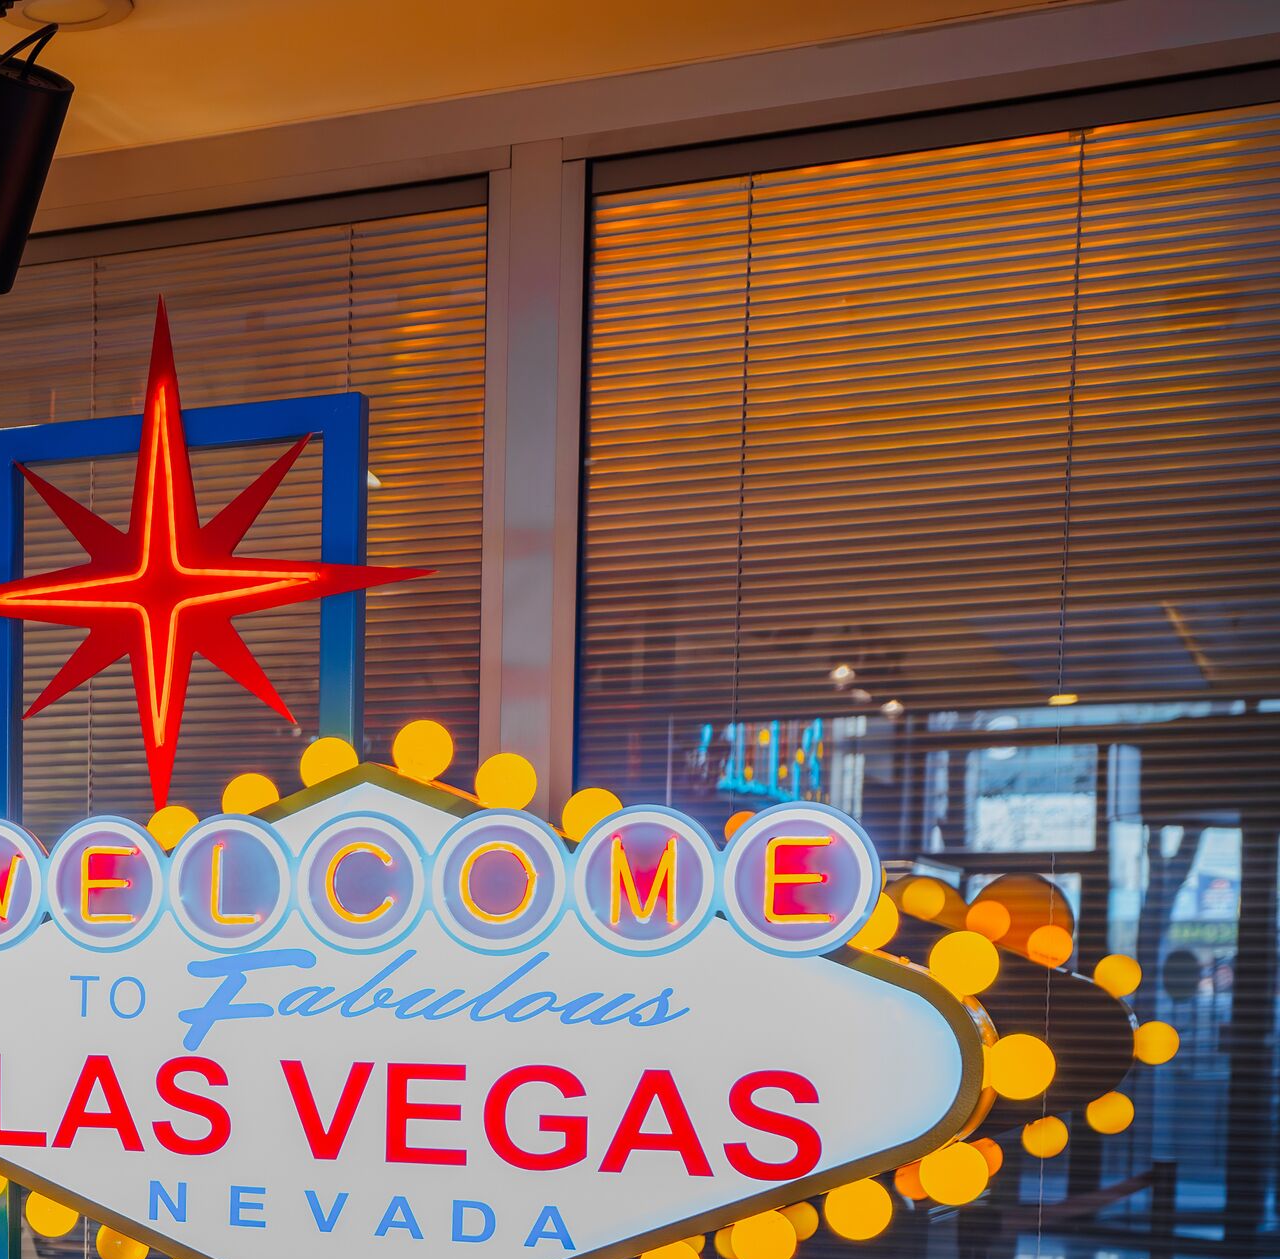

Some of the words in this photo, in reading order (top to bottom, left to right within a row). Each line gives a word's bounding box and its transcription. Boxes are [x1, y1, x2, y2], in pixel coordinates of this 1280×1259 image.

[70, 975, 146, 1019] TO
[178, 949, 690, 1052] Fabulous
[279, 1060, 823, 1181] VEGAS
[148, 1179, 577, 1250] NEVADA
